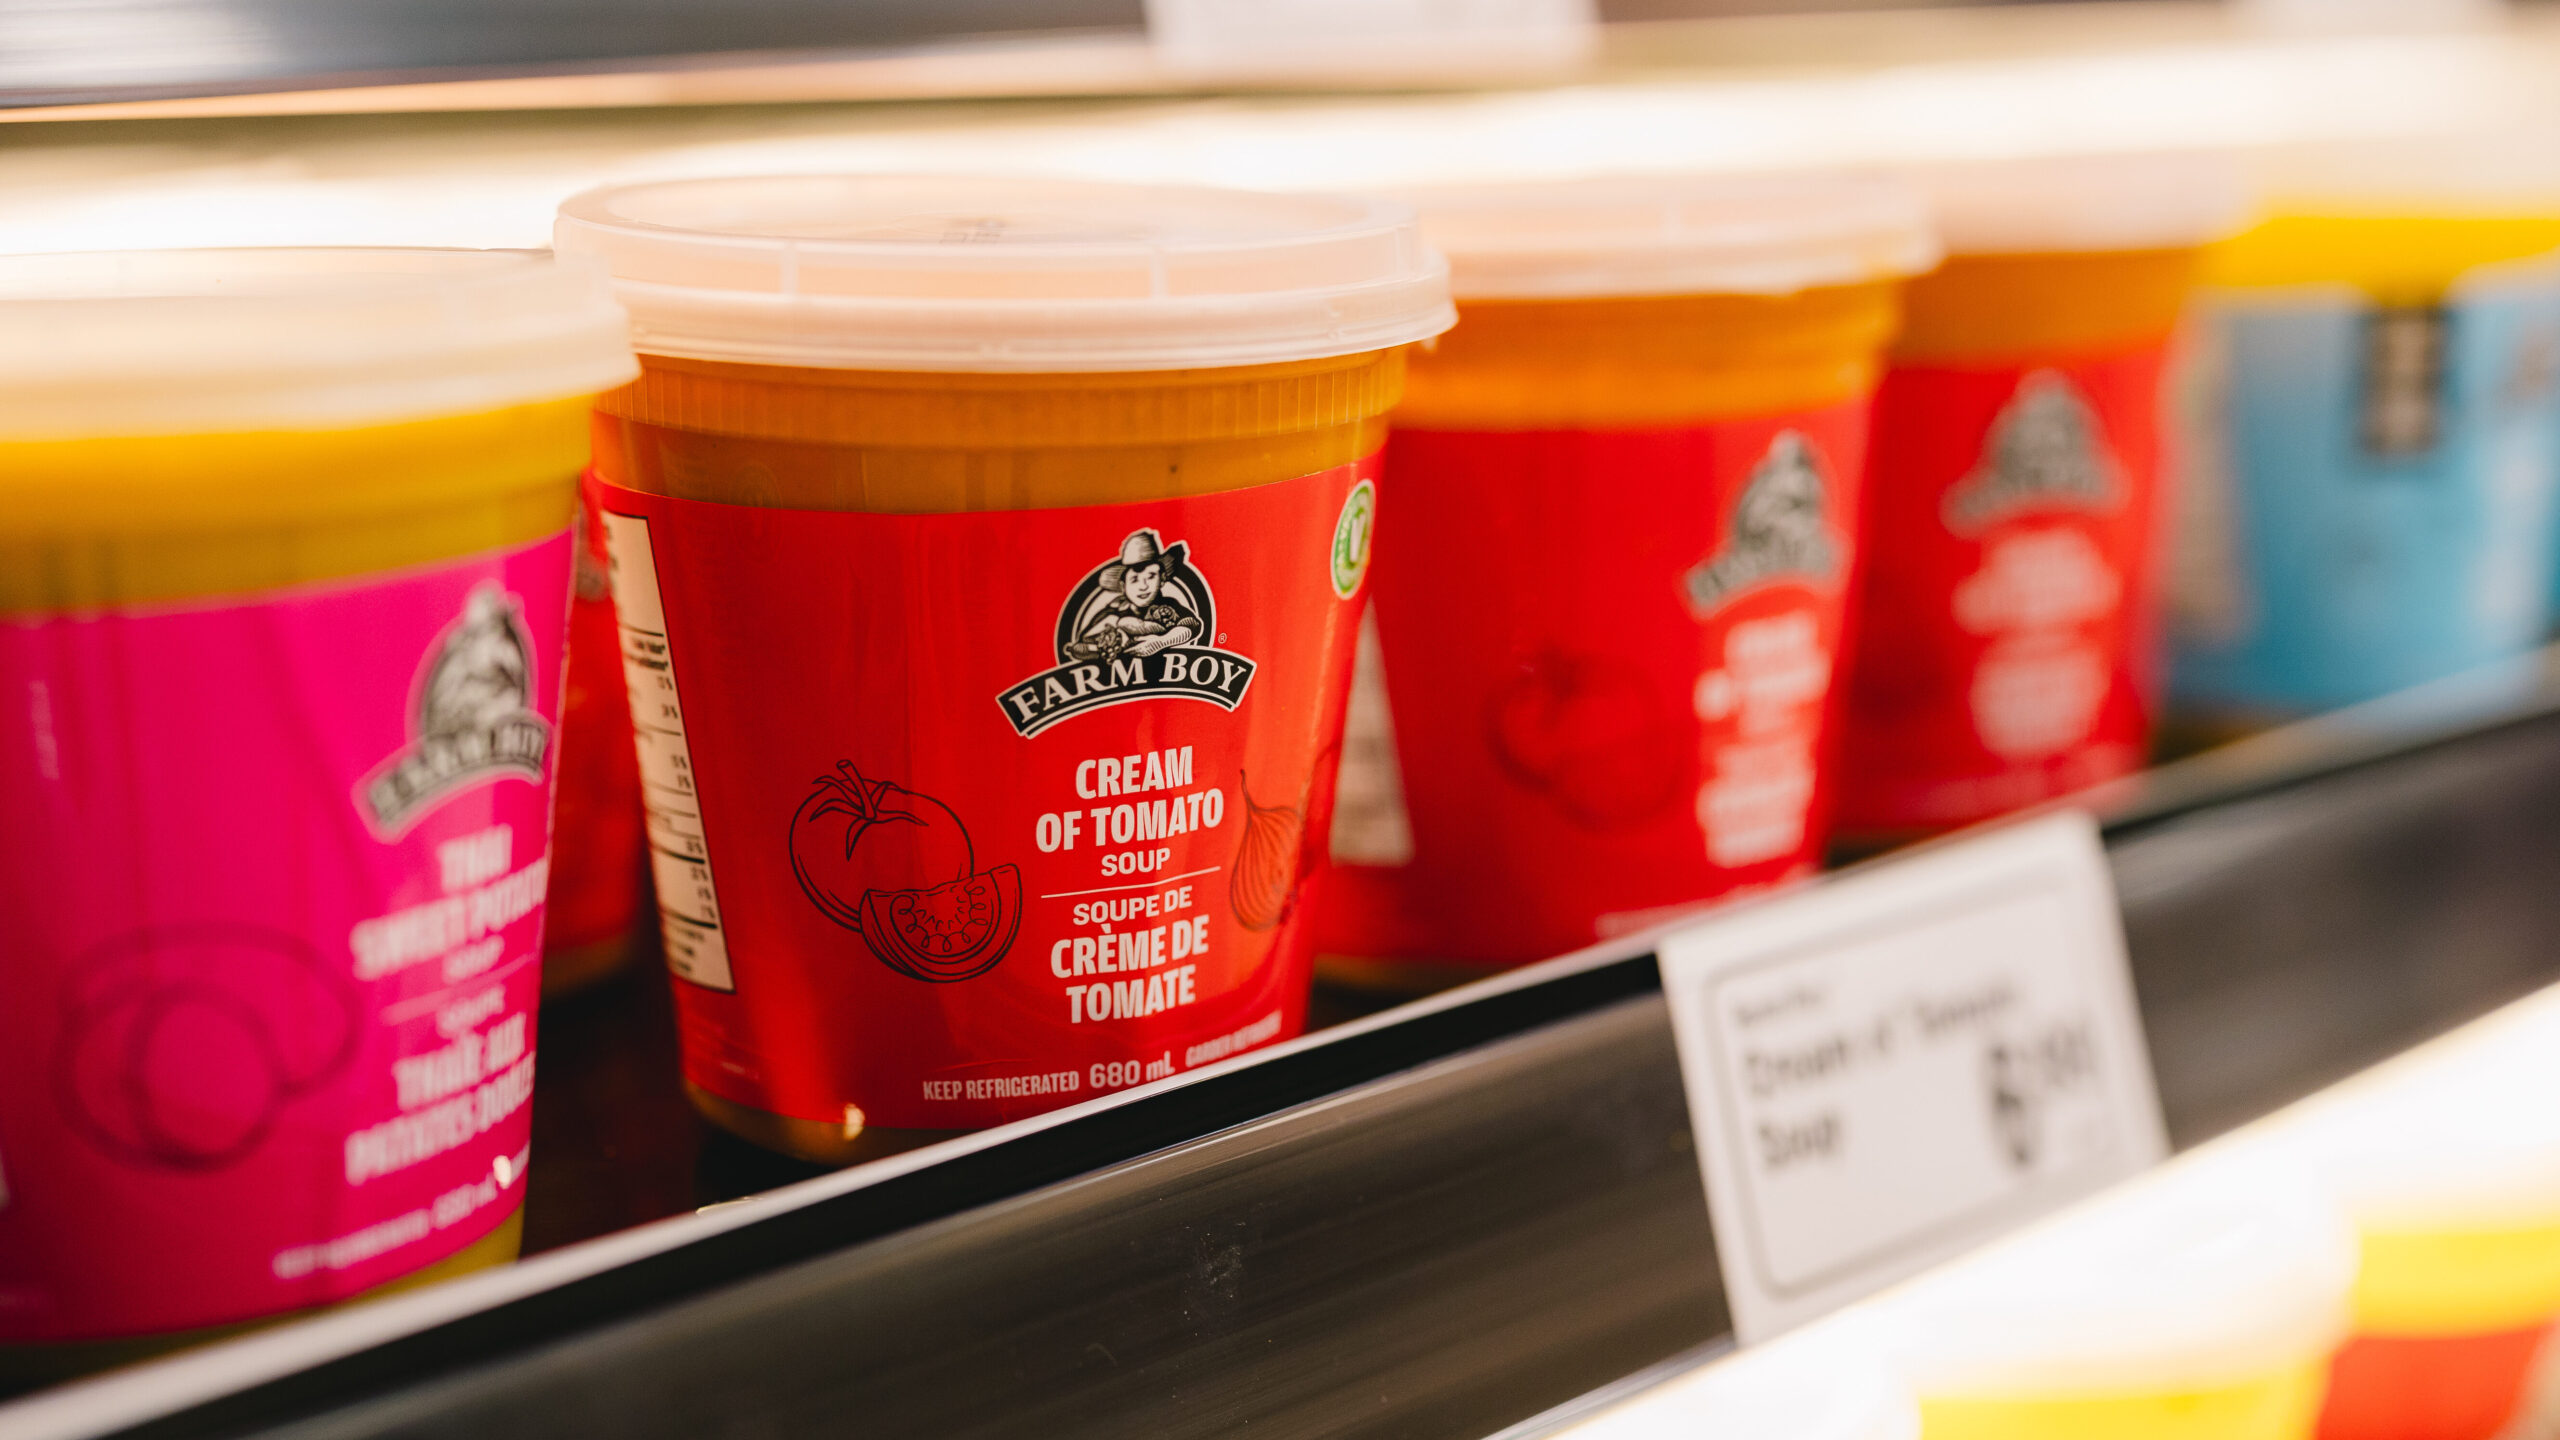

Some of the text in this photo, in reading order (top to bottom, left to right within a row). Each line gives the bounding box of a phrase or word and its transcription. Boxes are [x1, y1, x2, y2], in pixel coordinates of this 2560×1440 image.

[1008, 653, 1248, 724] FARM BOY
[1075, 745, 1193, 800] CREAM
[1035, 787, 1224, 853] OF TOMATO
[1101, 847, 1171, 877] SOUP
[1072, 885, 1193, 926] SOUPE DE
[1050, 914, 1210, 979] CRÈME DE
[1066, 964, 1196, 1024] TOMATE
[922, 1080, 963, 1102] KEEP
[966, 1071, 1080, 1101] REFRIGERATED
[1090, 1060, 1141, 1089] 680
[1146, 1051, 1175, 1082] mL
